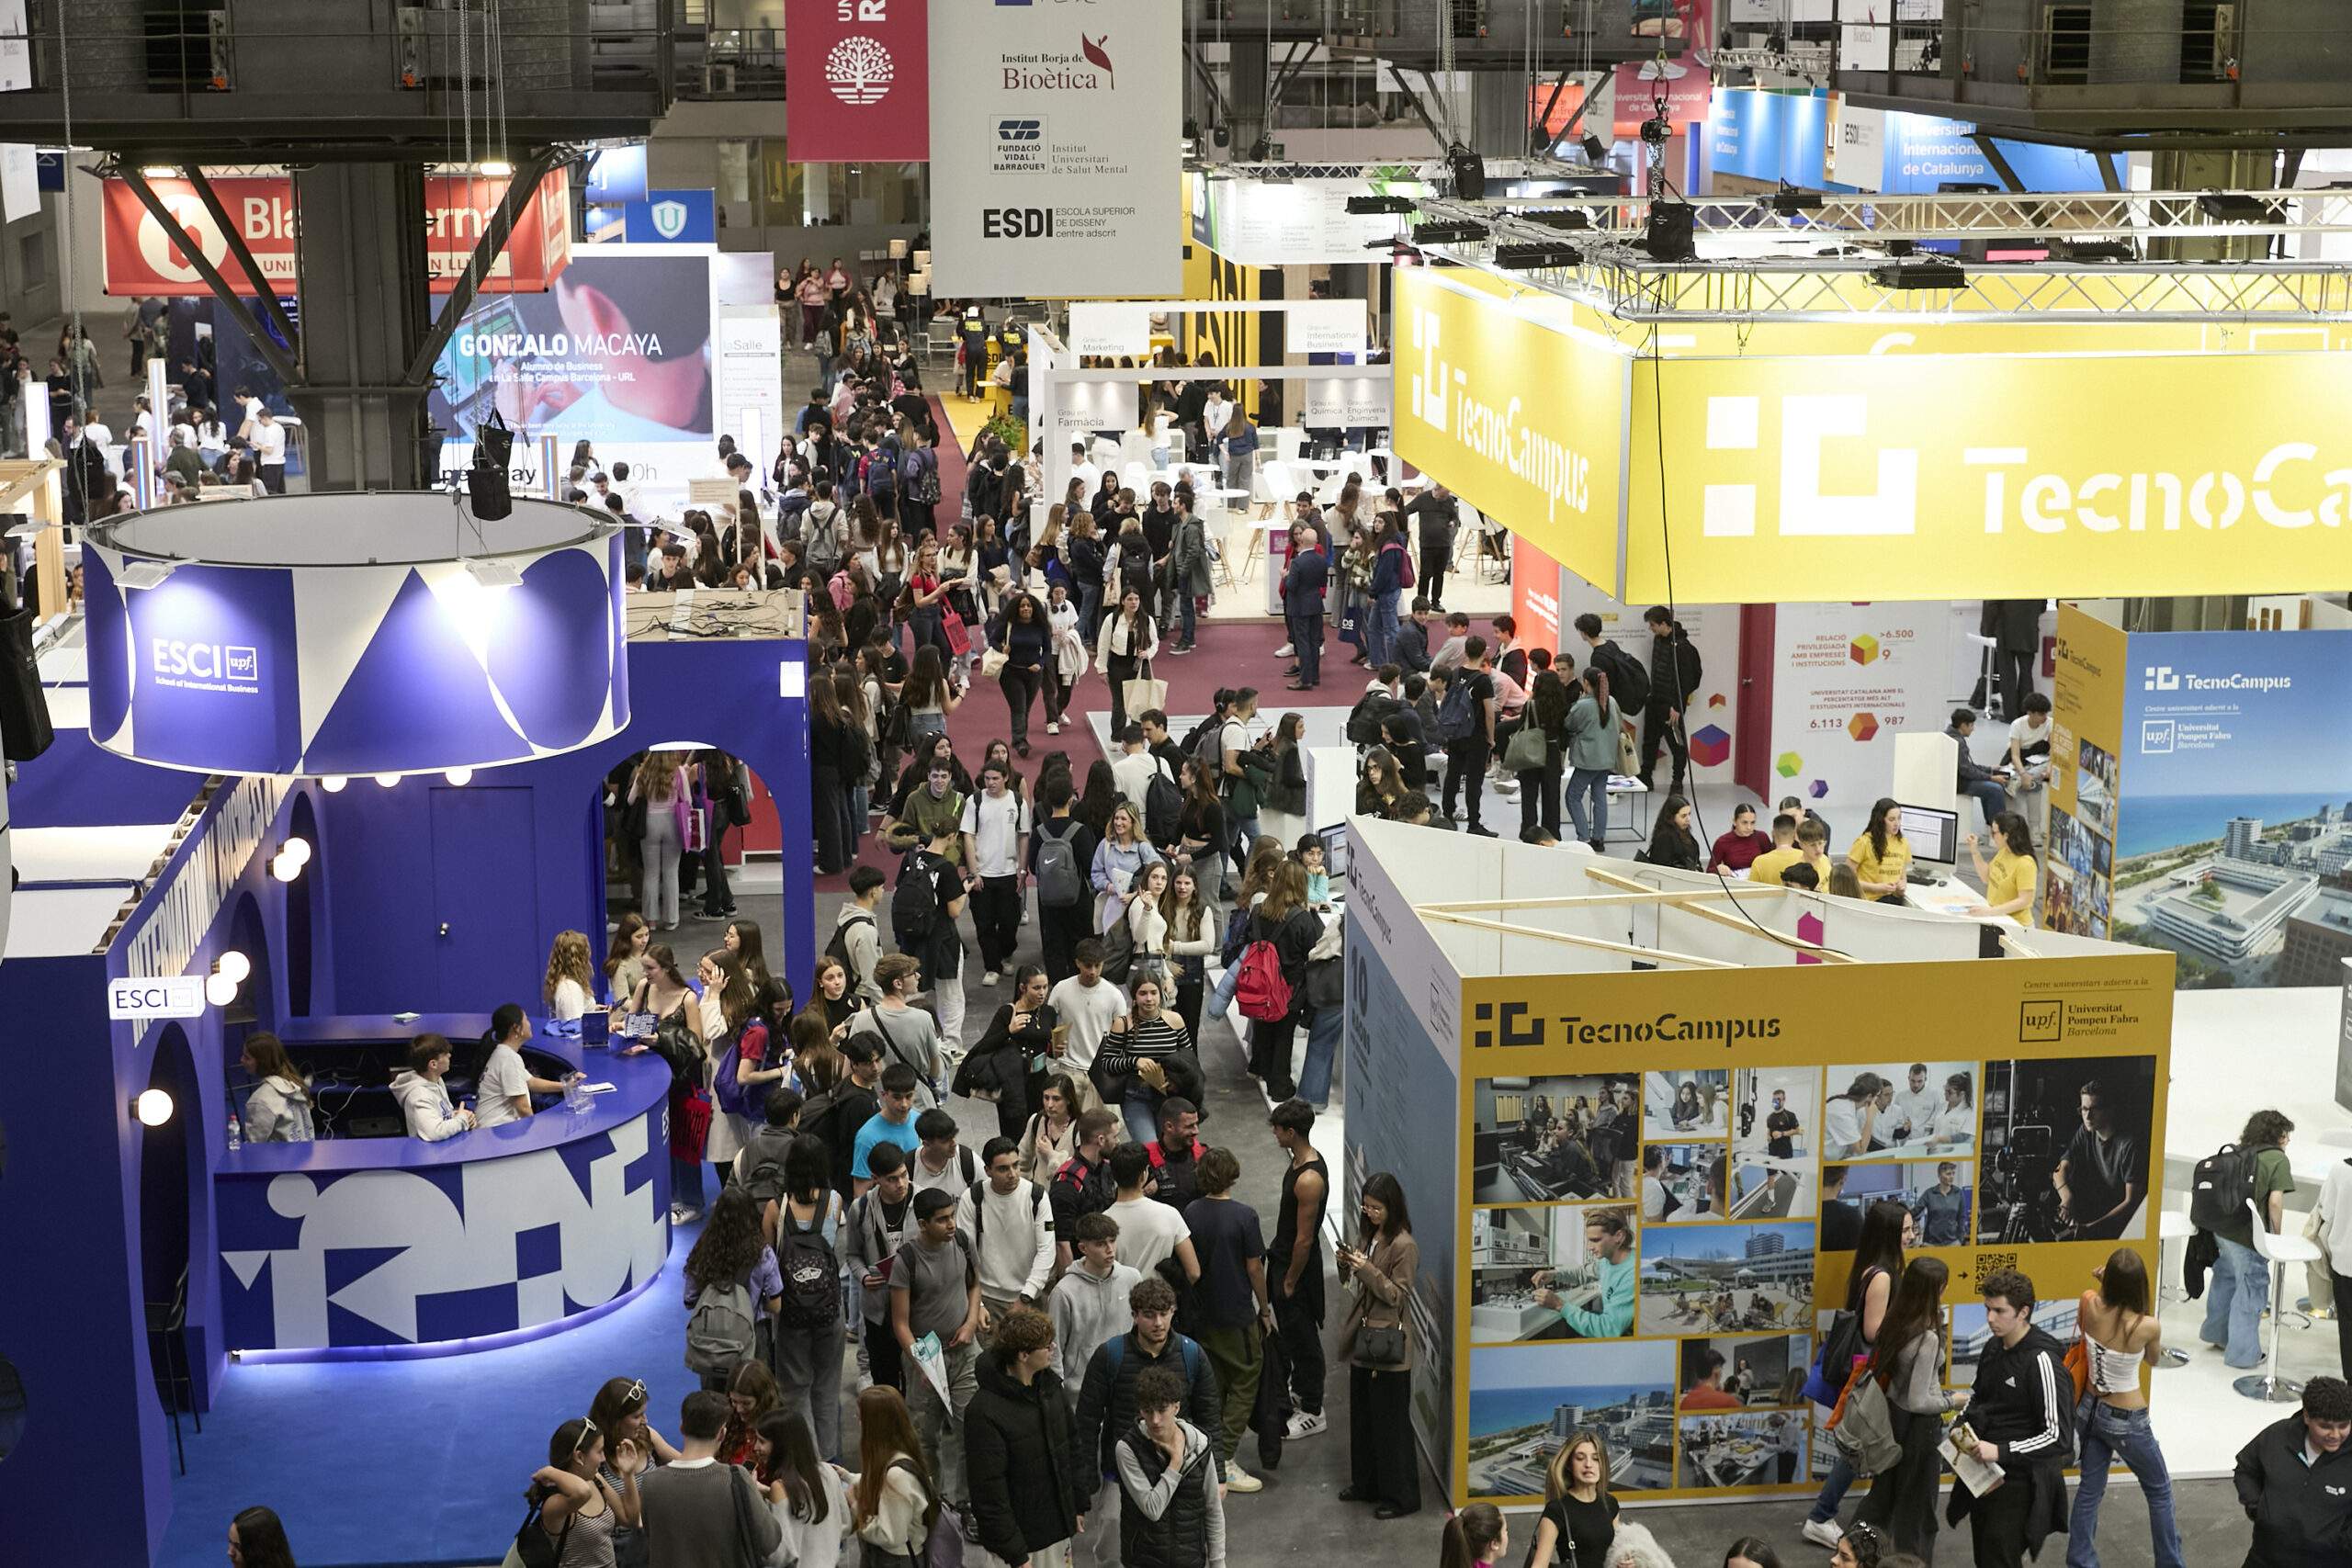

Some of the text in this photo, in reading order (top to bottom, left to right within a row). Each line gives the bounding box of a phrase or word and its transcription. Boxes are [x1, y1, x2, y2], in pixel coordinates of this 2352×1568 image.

[1001, 53, 1084, 66] Institut Borja de
[1002, 66, 1098, 90] Bioètica
[997, 143, 1042, 152] FUNDACIÓ
[1052, 144, 1087, 152] Institut
[1903, 142, 1983, 155] Internaciona
[1052, 154, 1109, 164] Universitari
[1052, 164, 1128, 174] de Salut Mental
[1903, 161, 1984, 177] de Catalunya
[1056, 207, 1136, 216] ESCOLA SUPERIOR
[983, 208, 1054, 239] ESDI
[1056, 219, 1107, 227] DE DISSENY
[1056, 229, 1116, 238] centre adscrit
[1306, 332, 1360, 340] International
[459, 333, 663, 357] GONZALO MACAYA
[1082, 343, 1125, 352] Marketing
[520, 361, 604, 371] Alumno de Business
[502, 373, 513, 382] La
[535, 373, 569, 384] Campus
[570, 373, 611, 382] Barcelona
[617, 373, 636, 382] URL
[1057, 417, 1104, 427] Farmàcia
[1454, 367, 1589, 523] TecnoCampus
[153, 637, 222, 679] ESCI
[1882, 649, 1891, 660] 9
[183, 680, 227, 692] International
[227, 683, 259, 694] Business
[2185, 673, 2291, 693] TecnoCampus
[1810, 718, 1843, 728] 6.113
[1884, 716, 1905, 725] 987
[2177, 723, 2220, 731] Universitat
[2177, 732, 2208, 741] Pompeu
[1358, 872, 1392, 945] TecnoCampus
[1351, 945, 1368, 1018] 10
[2053, 979, 2100, 988] universitari
[2103, 977, 2132, 987] adscrit
[2141, 977, 2148, 986] la
[115, 988, 168, 1009] ESCI
[2067, 1004, 2122, 1014] Universitat
[2026, 1010, 2057, 1030] upf.
[2067, 1014, 2139, 1026] Pompeu Fabra
[1559, 1012, 1781, 1048] TecnoCampus
[2067, 1026, 2117, 1037] Barcelona
